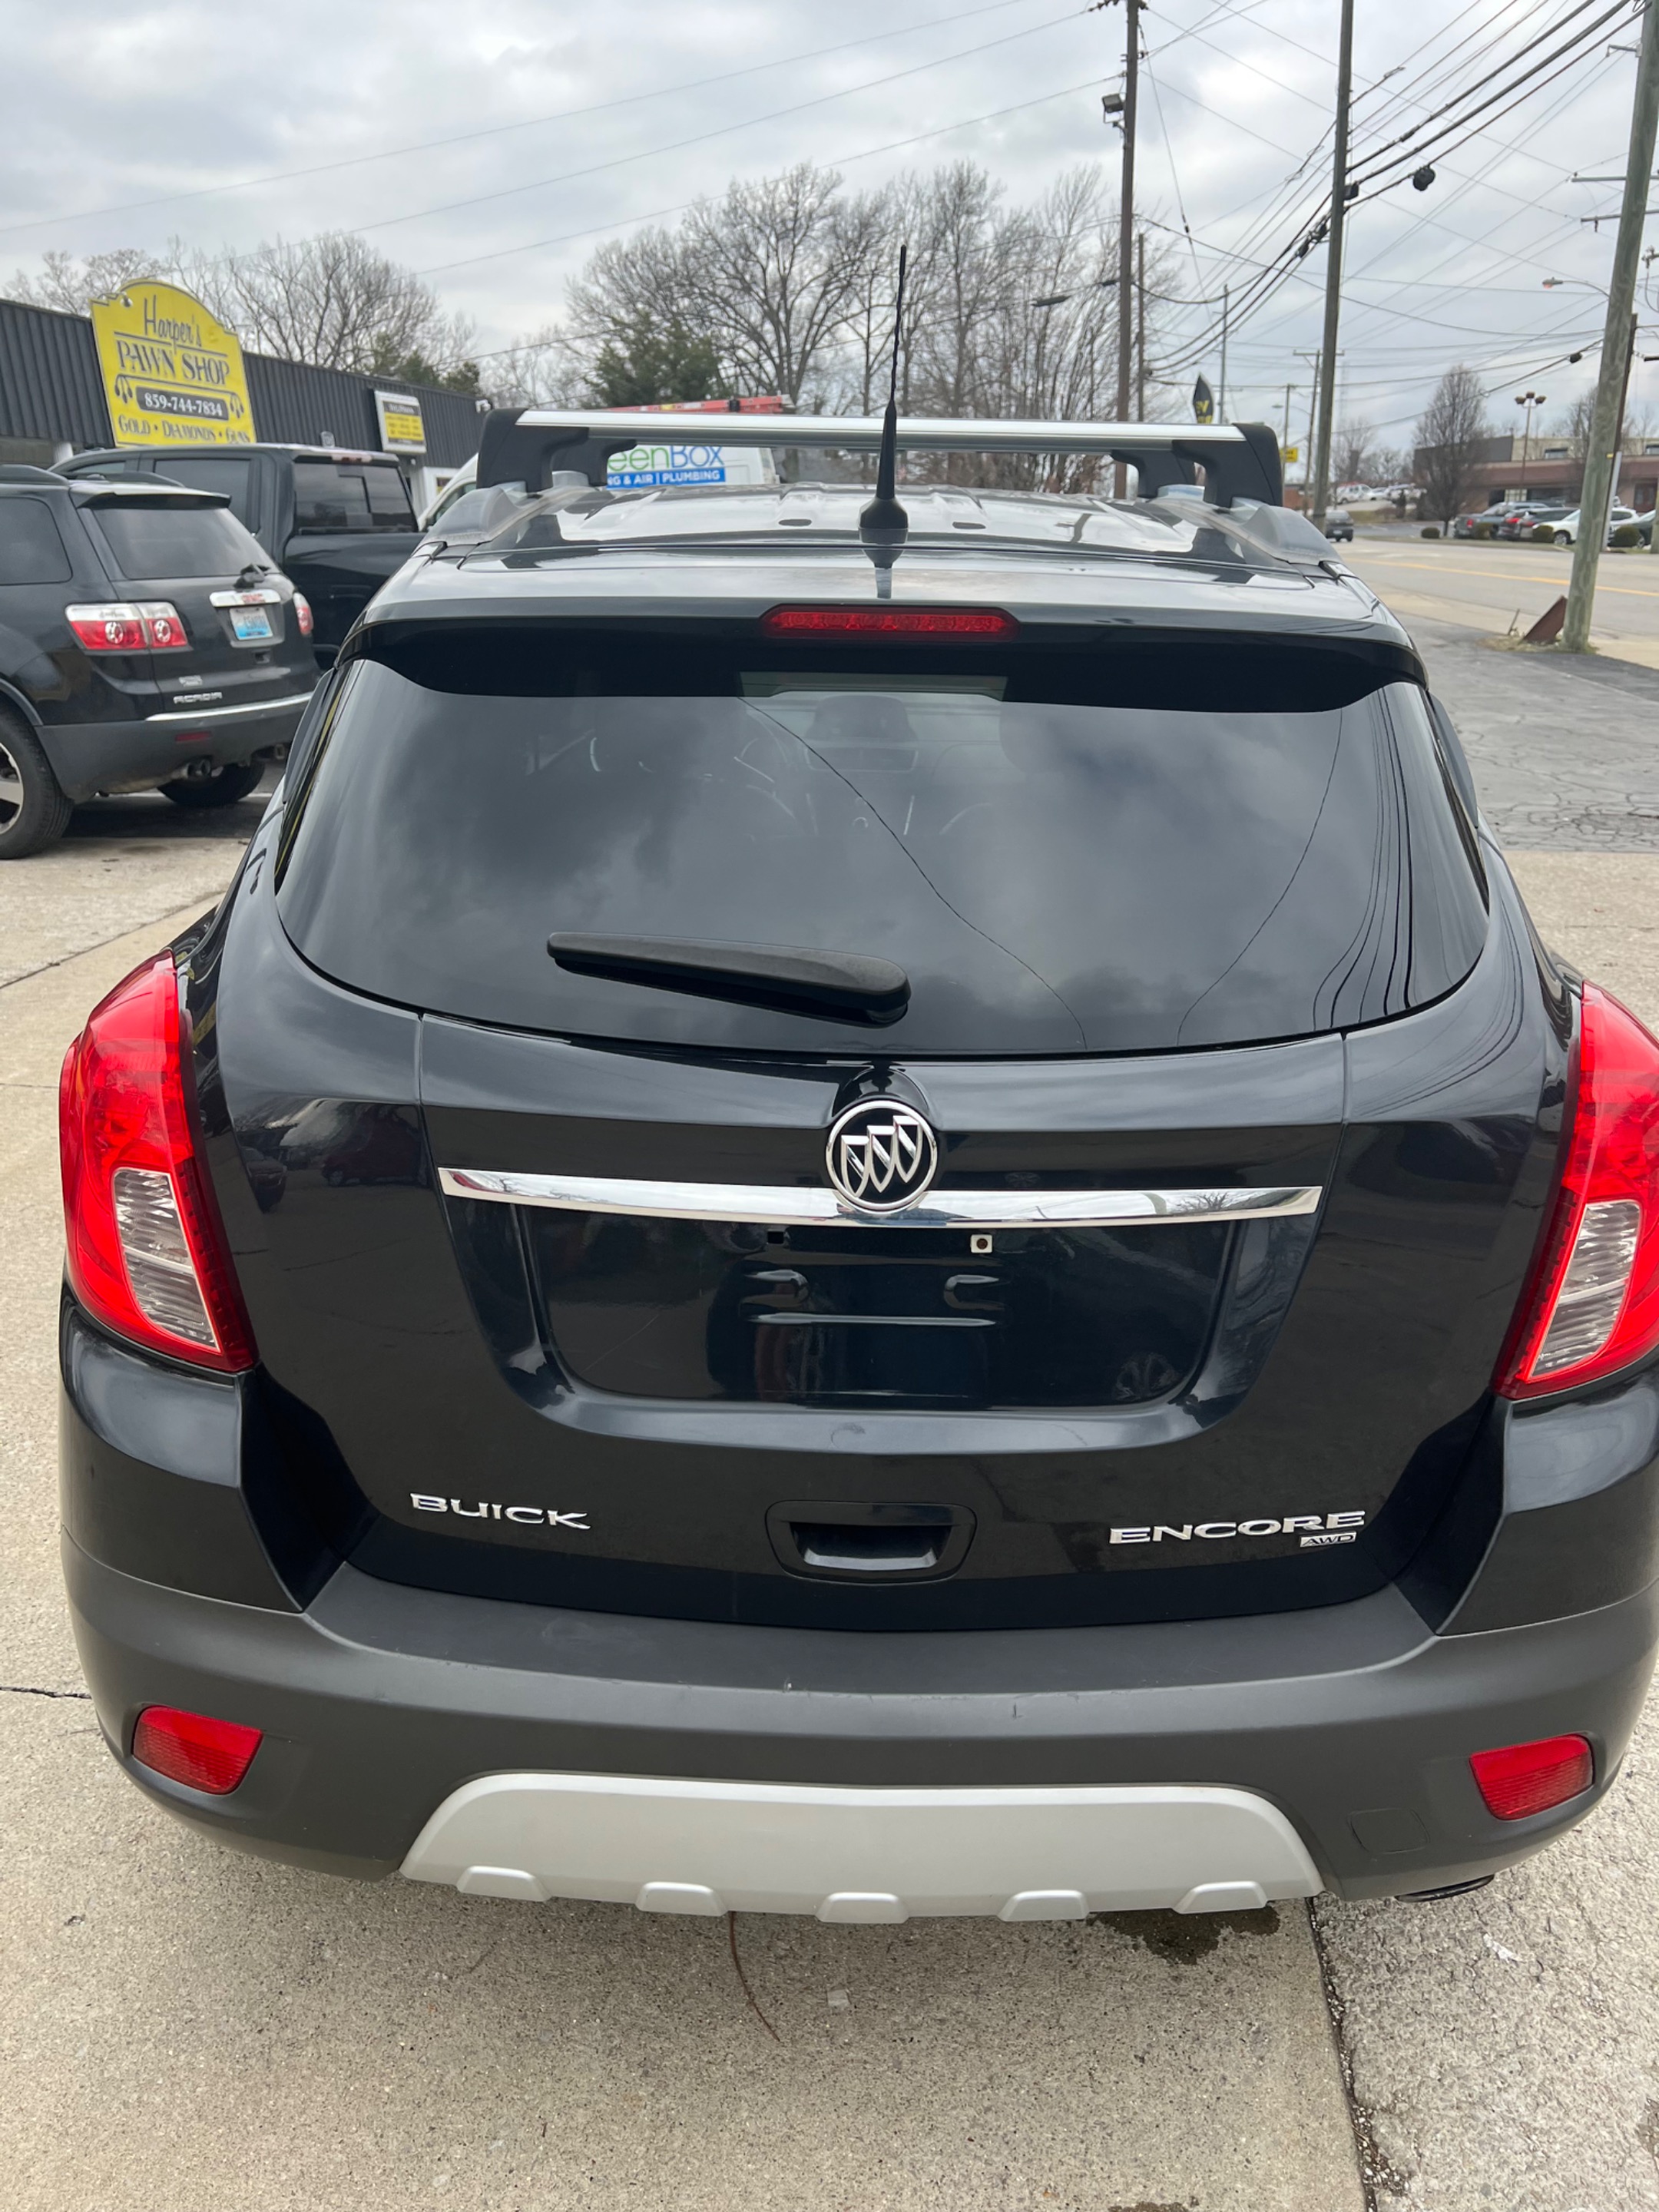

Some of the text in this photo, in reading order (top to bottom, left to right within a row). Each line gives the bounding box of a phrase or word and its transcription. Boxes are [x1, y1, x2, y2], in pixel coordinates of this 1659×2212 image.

[144, 294, 202, 355] Harper's
[117, 340, 230, 386] PAWN SHOP
[144, 392, 224, 416] 859-744-7834
[118, 415, 151, 435] GOLD
[634, 473, 654, 485] AIR
[662, 470, 720, 484] PLUMBING
[410, 1492, 591, 1530] BUICK
[1109, 1510, 1366, 1545] ENCORE
[1301, 1533, 1356, 1547] AWD
